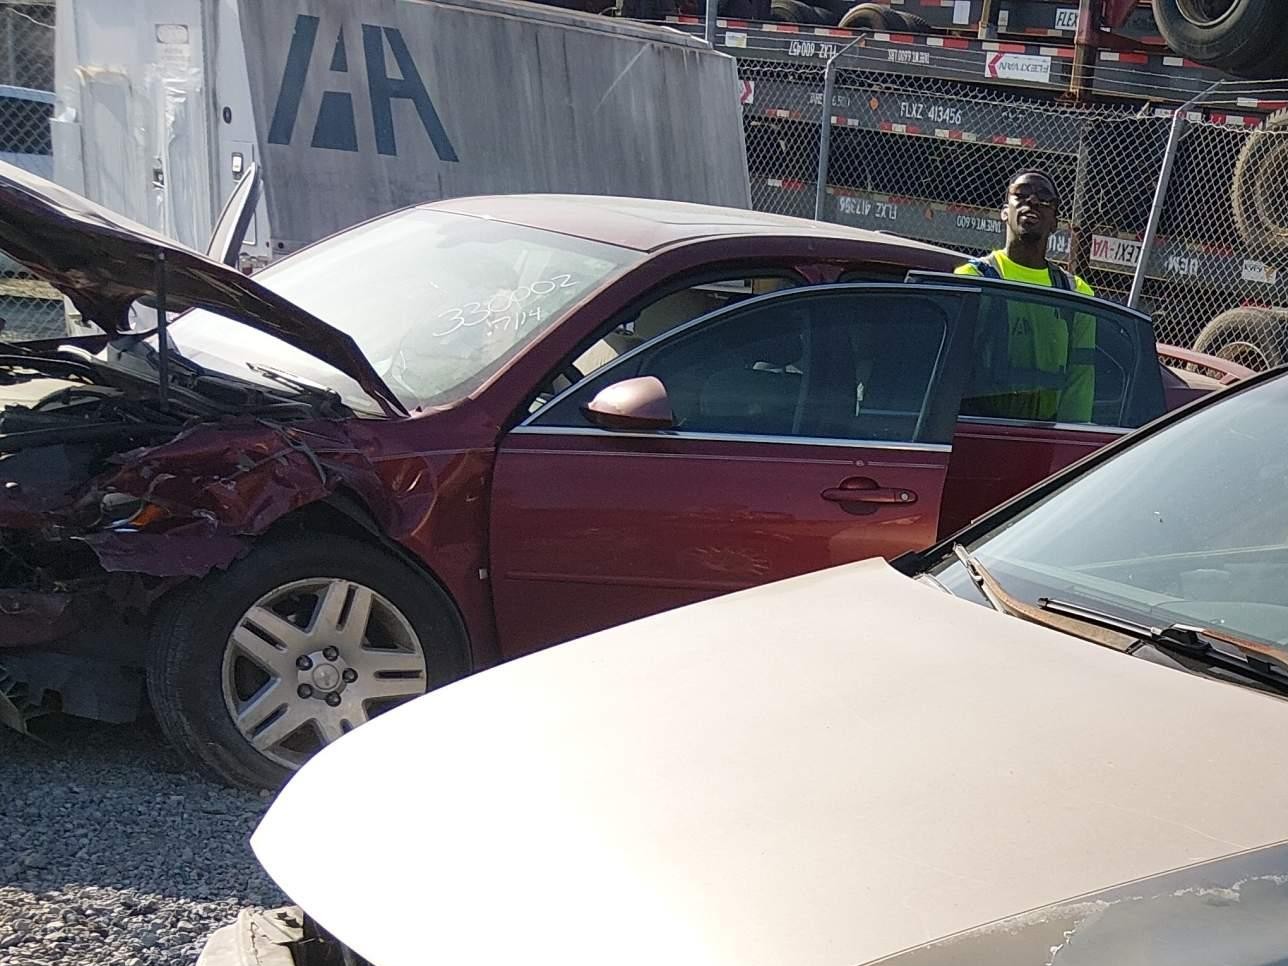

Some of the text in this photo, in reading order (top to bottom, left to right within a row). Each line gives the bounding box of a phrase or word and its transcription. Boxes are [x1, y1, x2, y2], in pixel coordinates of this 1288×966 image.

[1056, 11, 1079, 27] FLEX
[901, 102, 962, 125] FLXZ 413456
[876, 202, 898, 220] FLXZ
[1092, 238, 1142, 265] LEXI-VA
[432, 273, 578, 337] 330002
